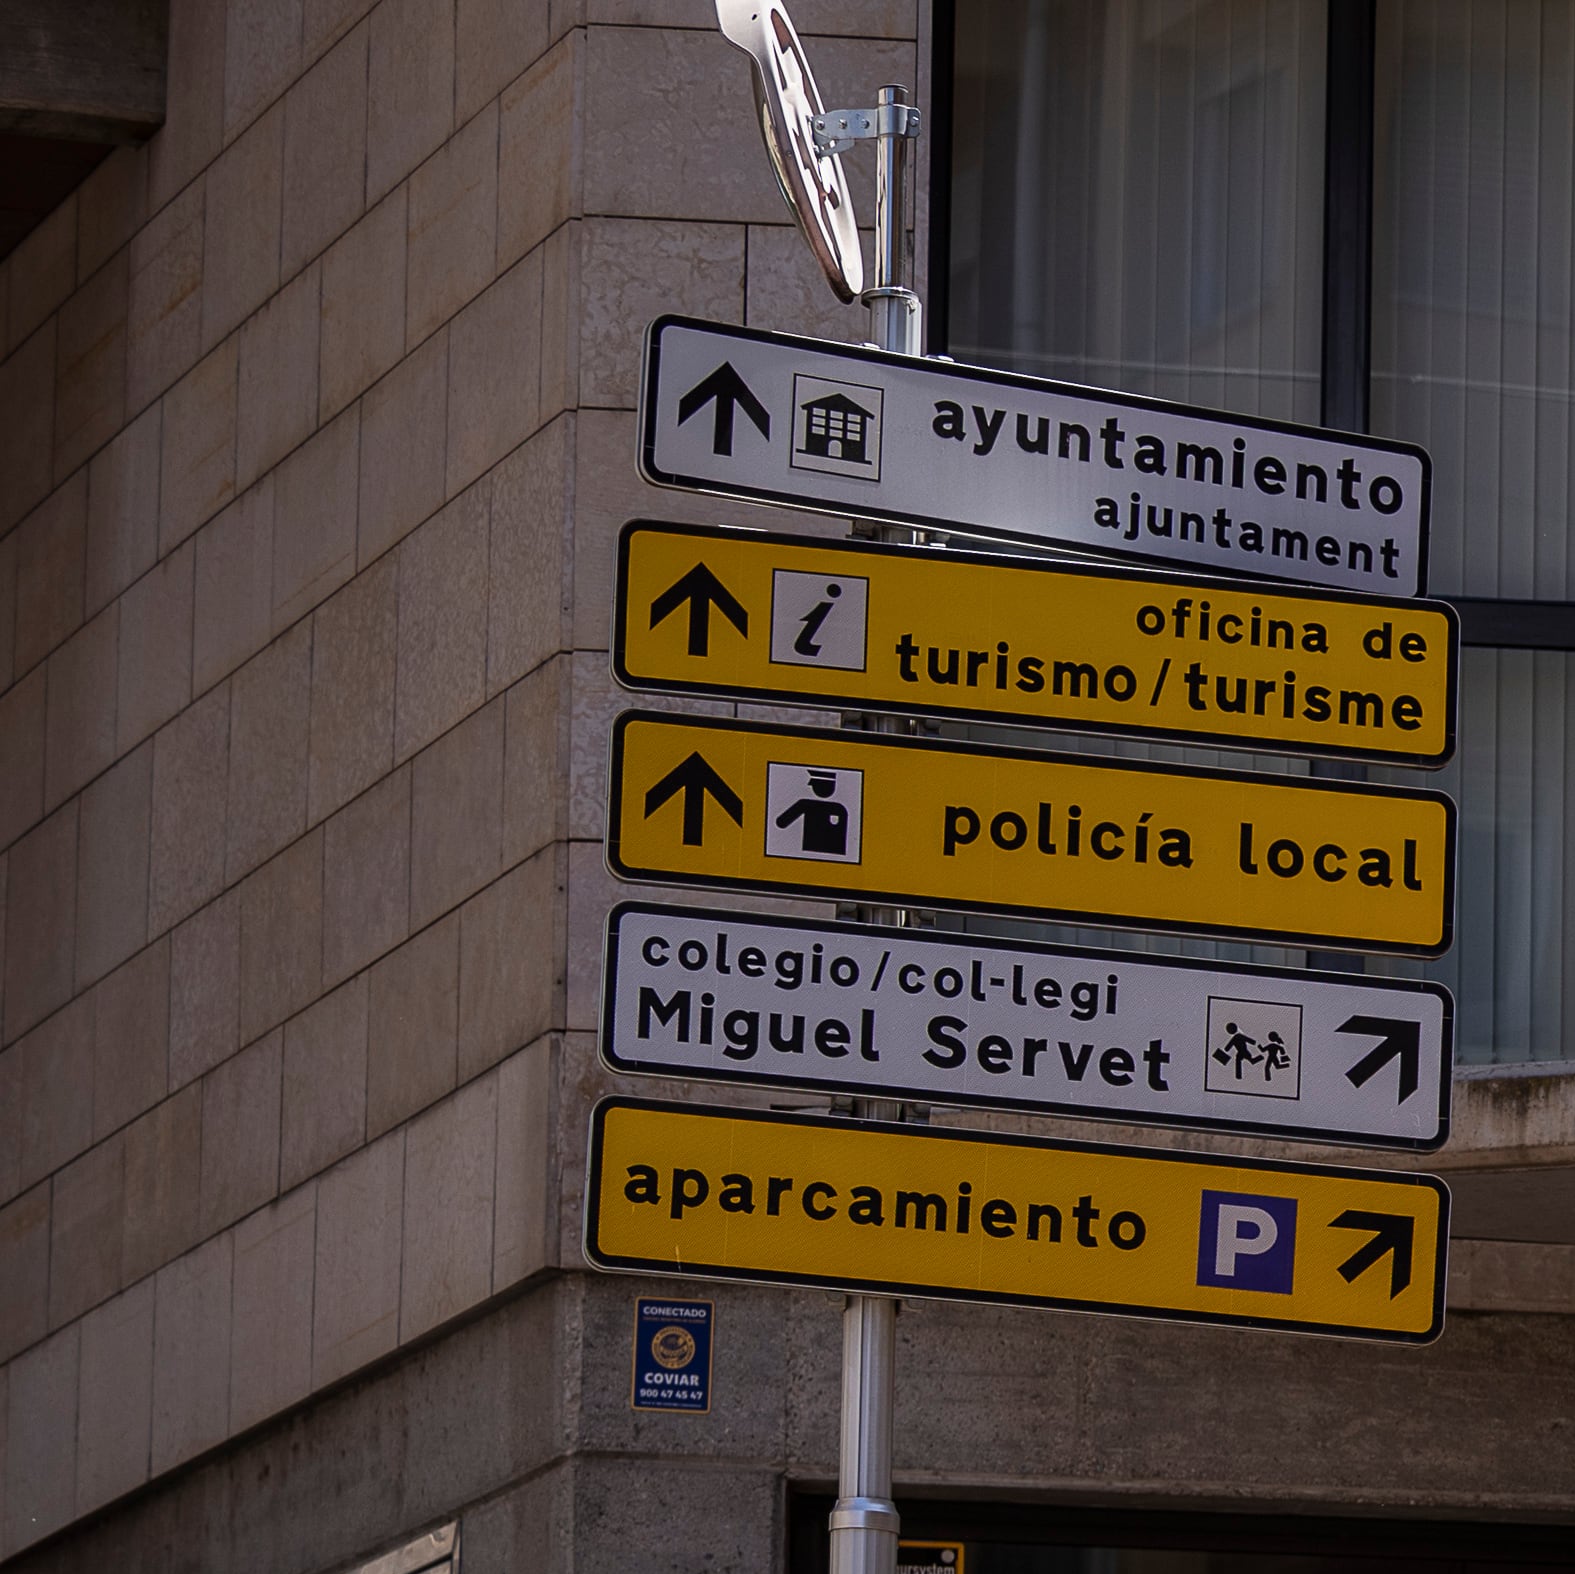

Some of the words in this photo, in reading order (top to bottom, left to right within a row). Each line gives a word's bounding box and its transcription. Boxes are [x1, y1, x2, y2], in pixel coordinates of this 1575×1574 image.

[932, 400, 1403, 515] ayuntamiento
[1093, 491, 1400, 579] ajuntament
[1136, 598, 1330, 654] oficina
[1362, 621, 1427, 663] de
[943, 803, 1194, 869] policía
[1239, 822, 1422, 892] local
[637, 986, 880, 1062] Miguel
[921, 1015, 1172, 1092] Servet
[623, 1164, 1147, 1251] aparcamiento
[1214, 1202, 1279, 1277] P
[643, 1306, 707, 1318] CONECTADO
[640, 1388, 658, 1398] 900
[661, 1389, 674, 1398] 47
[690, 1391, 703, 1400] 47
[644, 1373, 699, 1386] COVIAR
